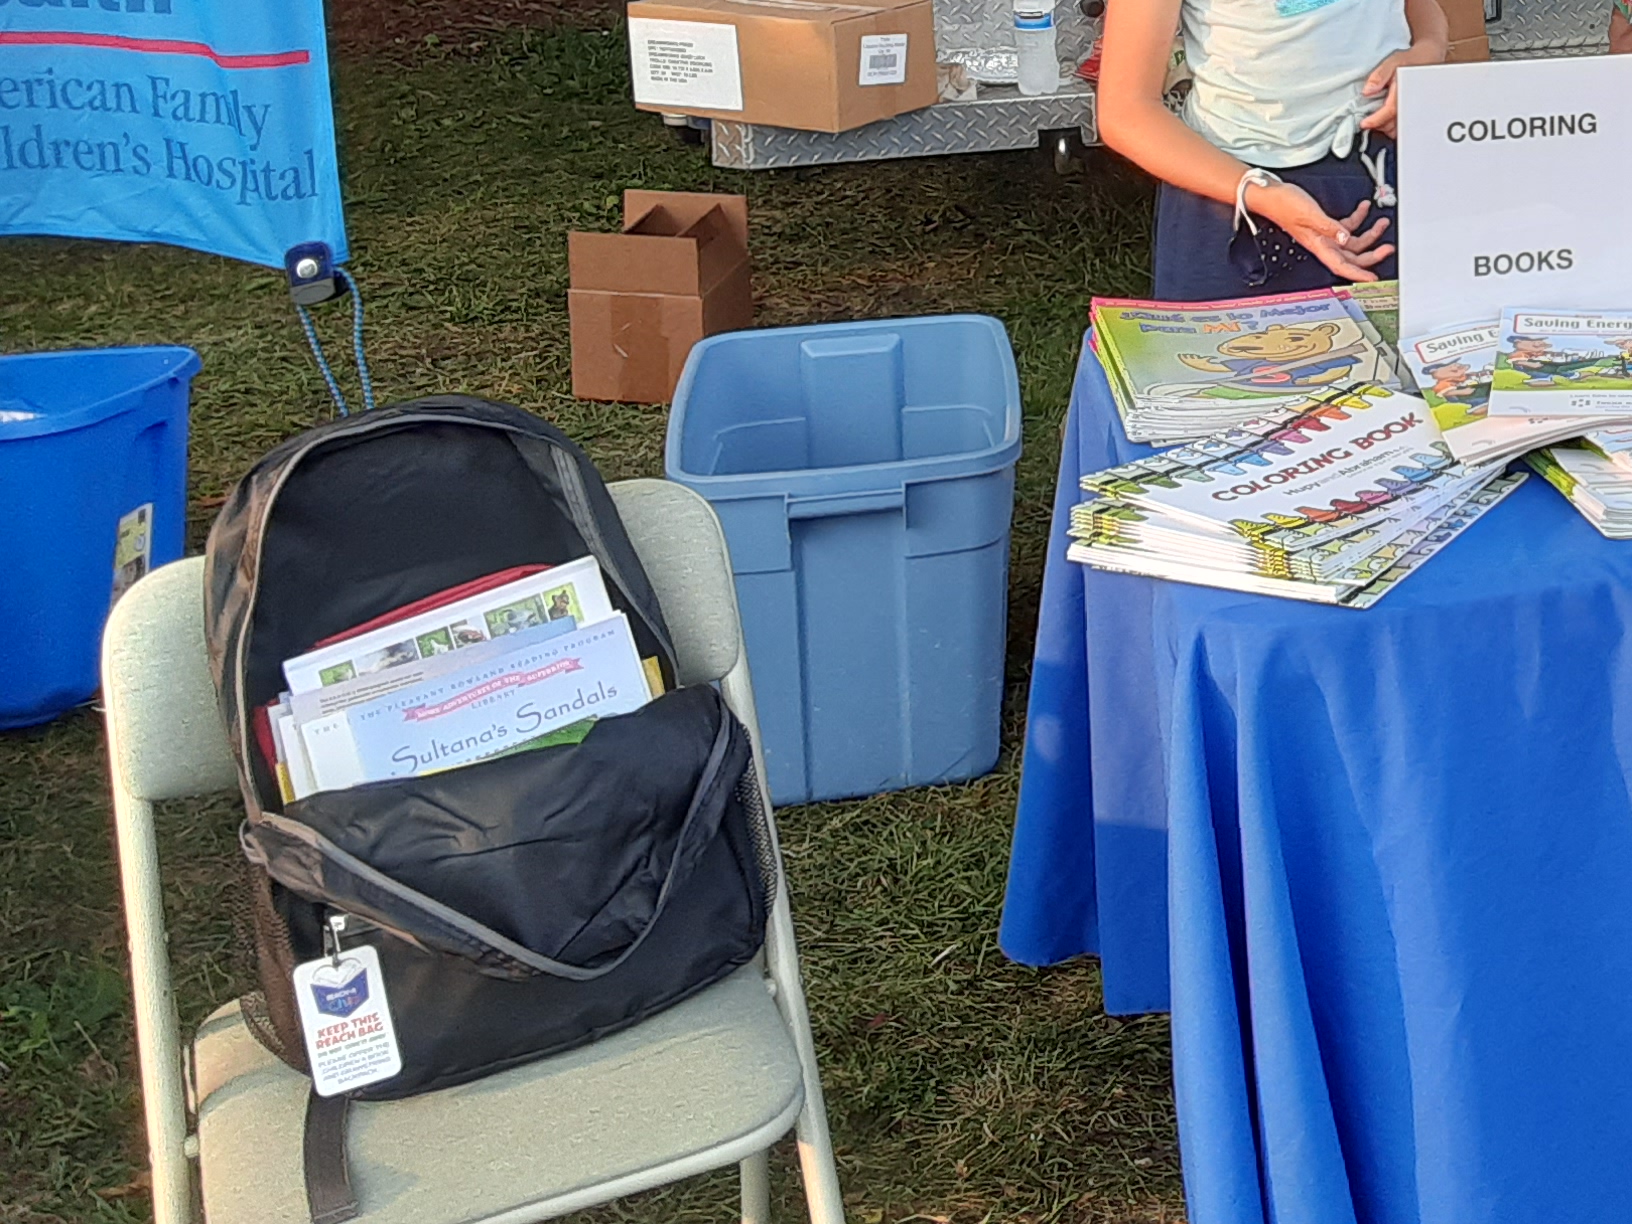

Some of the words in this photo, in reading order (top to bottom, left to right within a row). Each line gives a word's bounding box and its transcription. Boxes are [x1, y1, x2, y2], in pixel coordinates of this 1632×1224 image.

[1446, 112, 1598, 143] COLORING
[1473, 248, 1574, 277] BOOKS
[1260, 302, 1332, 319] Mejor
[1524, 316, 1581, 332] Saving
[1426, 330, 1487, 354] Saving
[1211, 447, 1354, 501] COLORING
[1350, 412, 1424, 450] BOOK
[1282, 482, 1321, 496] Hupy
[1340, 450, 1394, 476] Abraham
[510, 648, 559, 670] READING
[564, 630, 616, 652] PROGRAM
[390, 723, 509, 776] Sultana's
[515, 681, 619, 734] Sandals
[315, 1031, 357, 1050] REACH
[358, 1022, 384, 1037] BAG
[317, 1021, 350, 1039] KEEP
[350, 1012, 380, 1028] THIS
